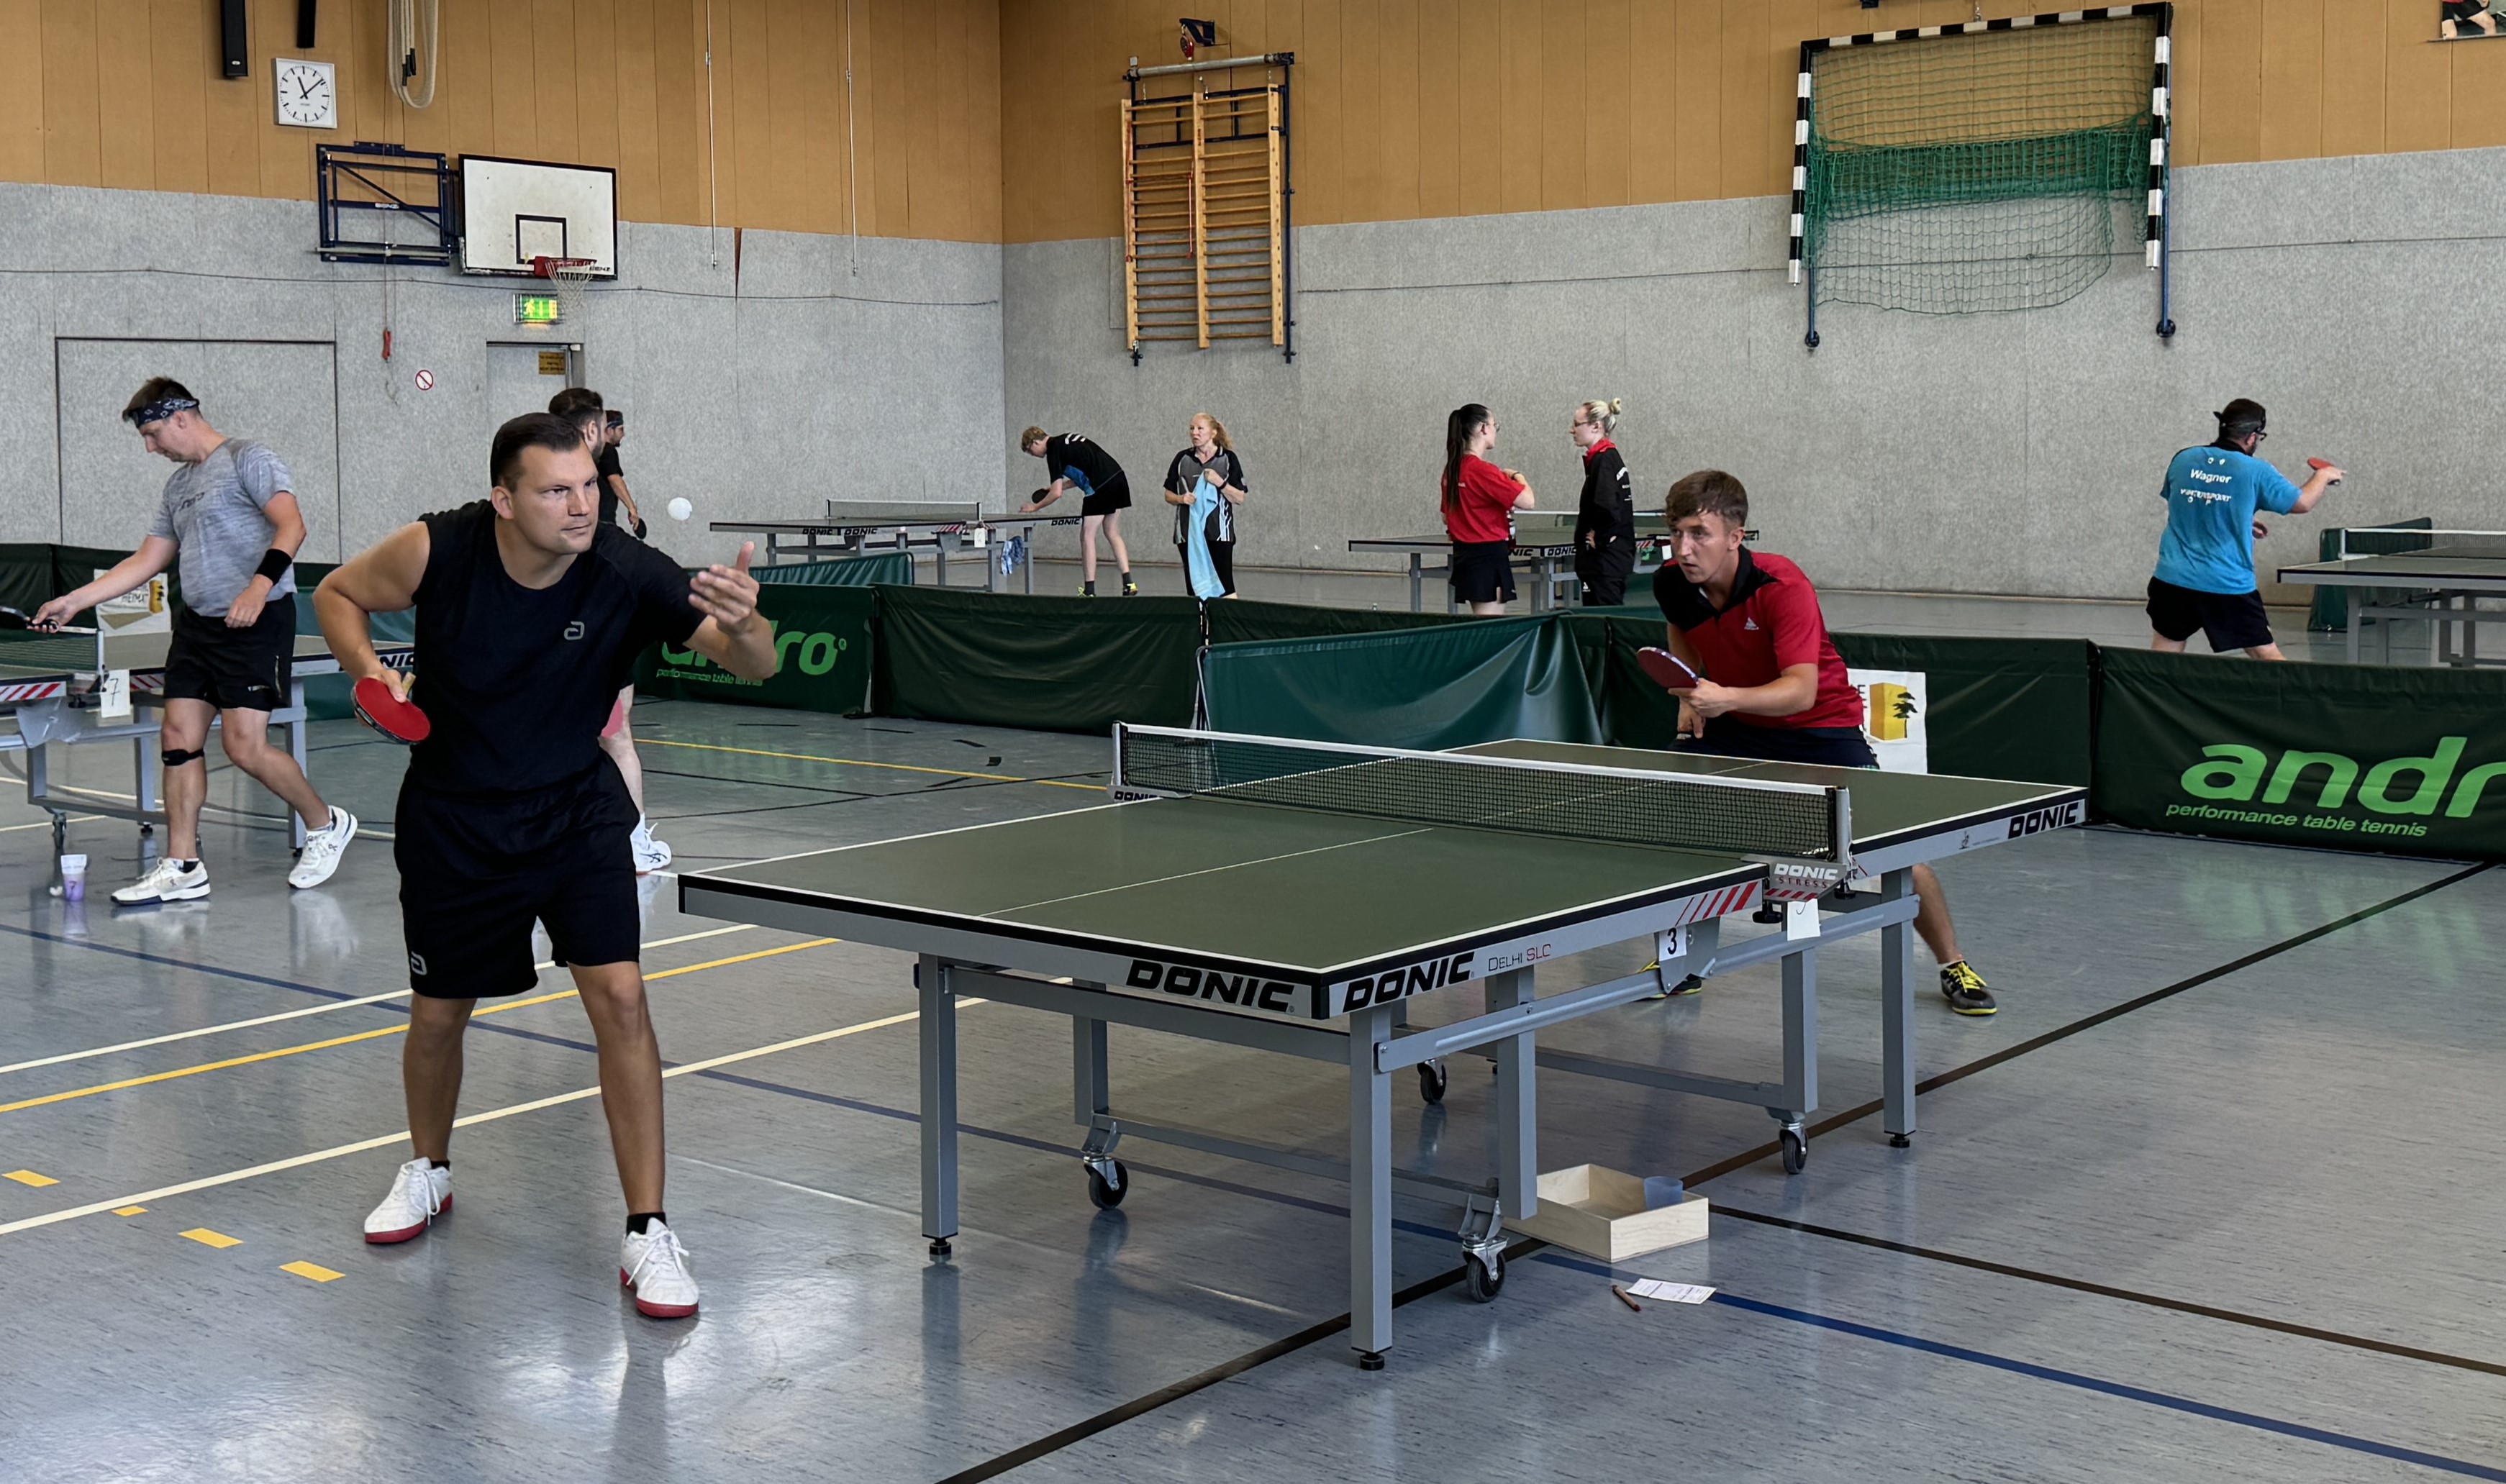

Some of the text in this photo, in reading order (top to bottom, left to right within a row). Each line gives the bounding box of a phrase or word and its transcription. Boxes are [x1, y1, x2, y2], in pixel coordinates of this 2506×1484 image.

[2191, 468, 2232, 483] Wagner
[379, 654, 414, 668] NIC
[110, 678, 119, 706] 7
[2180, 736, 2506, 818] andr
[2007, 802, 2079, 839] DONIC
[2166, 804, 2428, 837] performance table tennis
[1774, 863, 1838, 880] DONIC
[1667, 927, 1677, 955] 3
[1126, 959, 1294, 1013] DONIC
[1342, 951, 1475, 1013] DONIC
[1526, 943, 1551, 961] SLC
